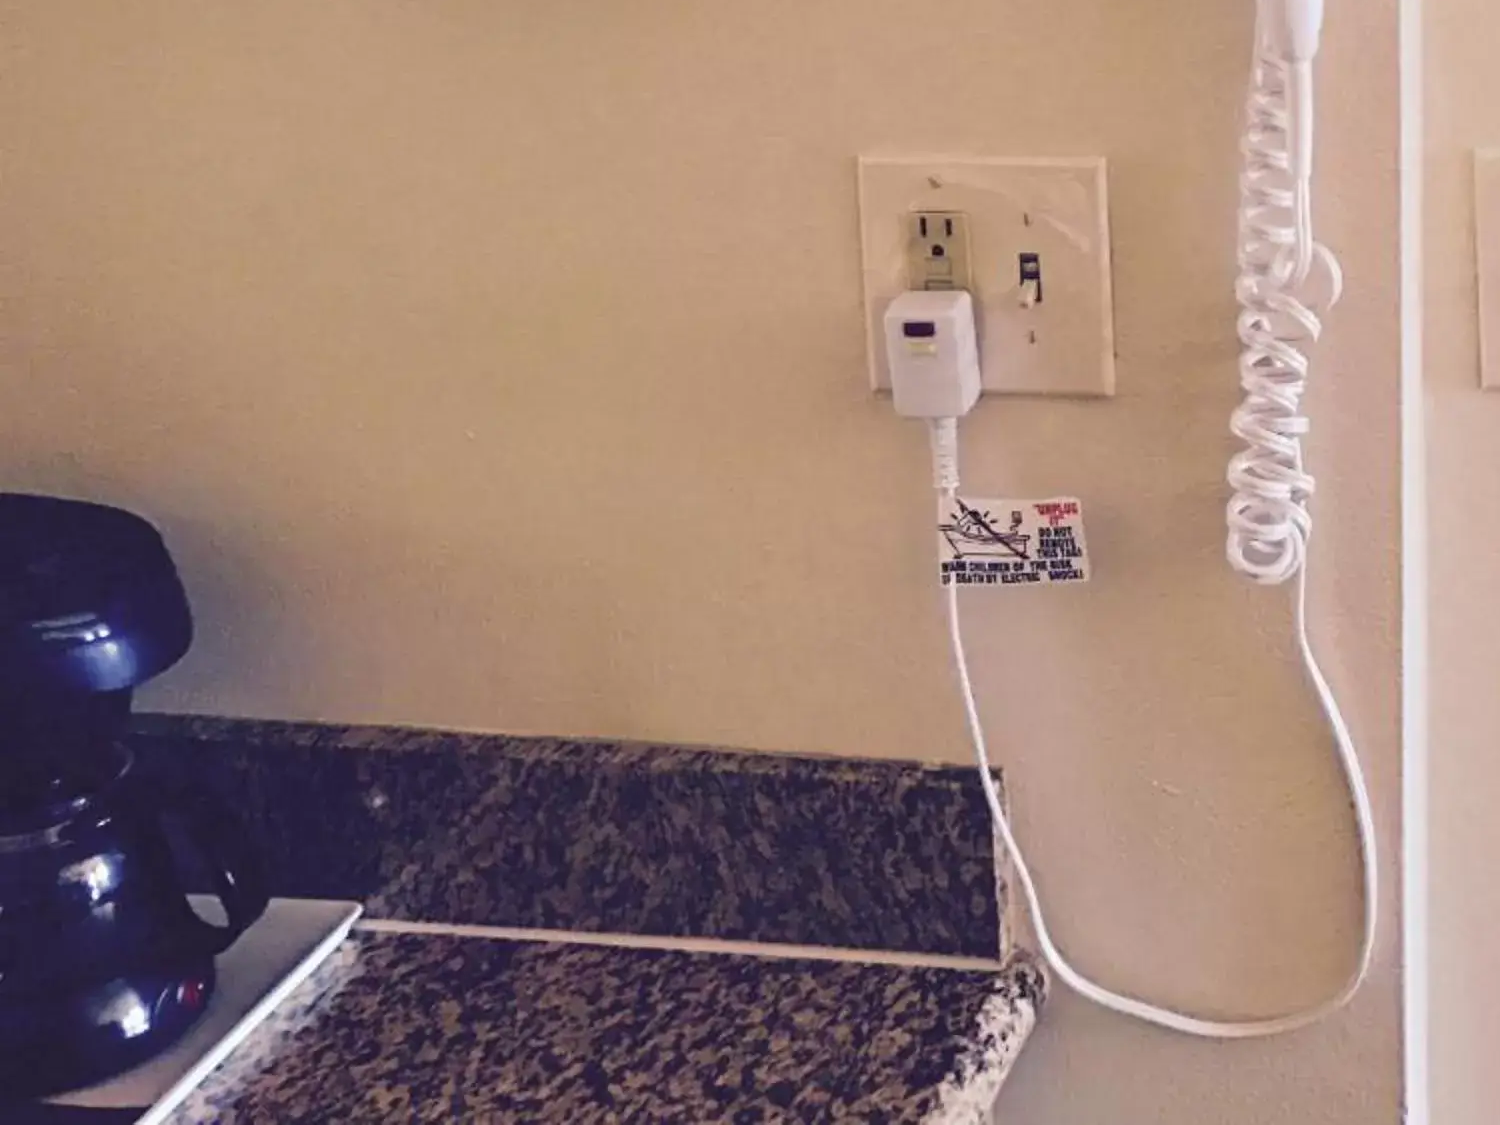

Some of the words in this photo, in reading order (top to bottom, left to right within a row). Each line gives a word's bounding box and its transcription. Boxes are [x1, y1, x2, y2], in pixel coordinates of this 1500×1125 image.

[1038, 527, 1051, 537] DO
[1054, 526, 1072, 537] NOT
[1039, 537, 1076, 547] REMOVE
[1037, 548, 1058, 558] THIS
[941, 561, 966, 572] WARN
[969, 562, 1010, 572] CHILDREN
[1013, 562, 1024, 571] OF
[1030, 561, 1047, 571] THE
[1050, 559, 1072, 570] RISK
[956, 573, 984, 583] DEATH
[986, 573, 997, 583] BY
[1001, 573, 1041, 583] ELECTRIC
